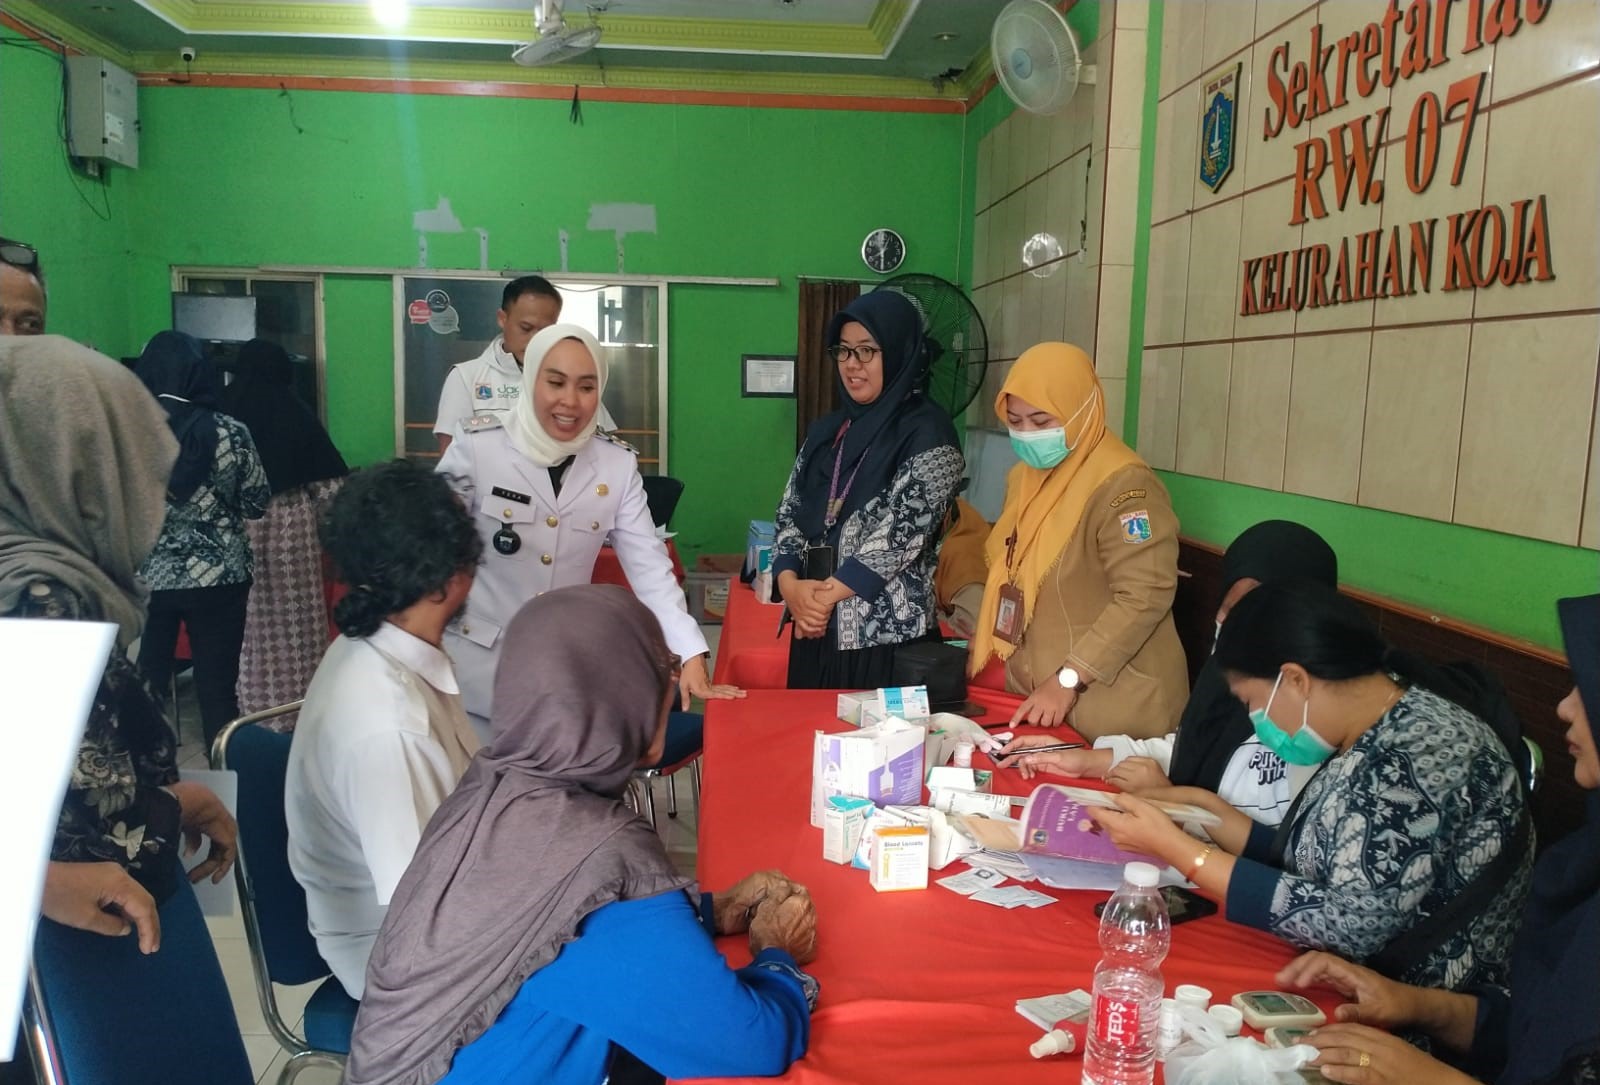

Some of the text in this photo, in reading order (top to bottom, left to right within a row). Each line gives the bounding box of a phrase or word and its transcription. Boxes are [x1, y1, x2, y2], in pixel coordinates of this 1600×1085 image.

[1288, 72, 1488, 226] RW. 07
[1240, 195, 1555, 316] KELURAHAN KOJA
